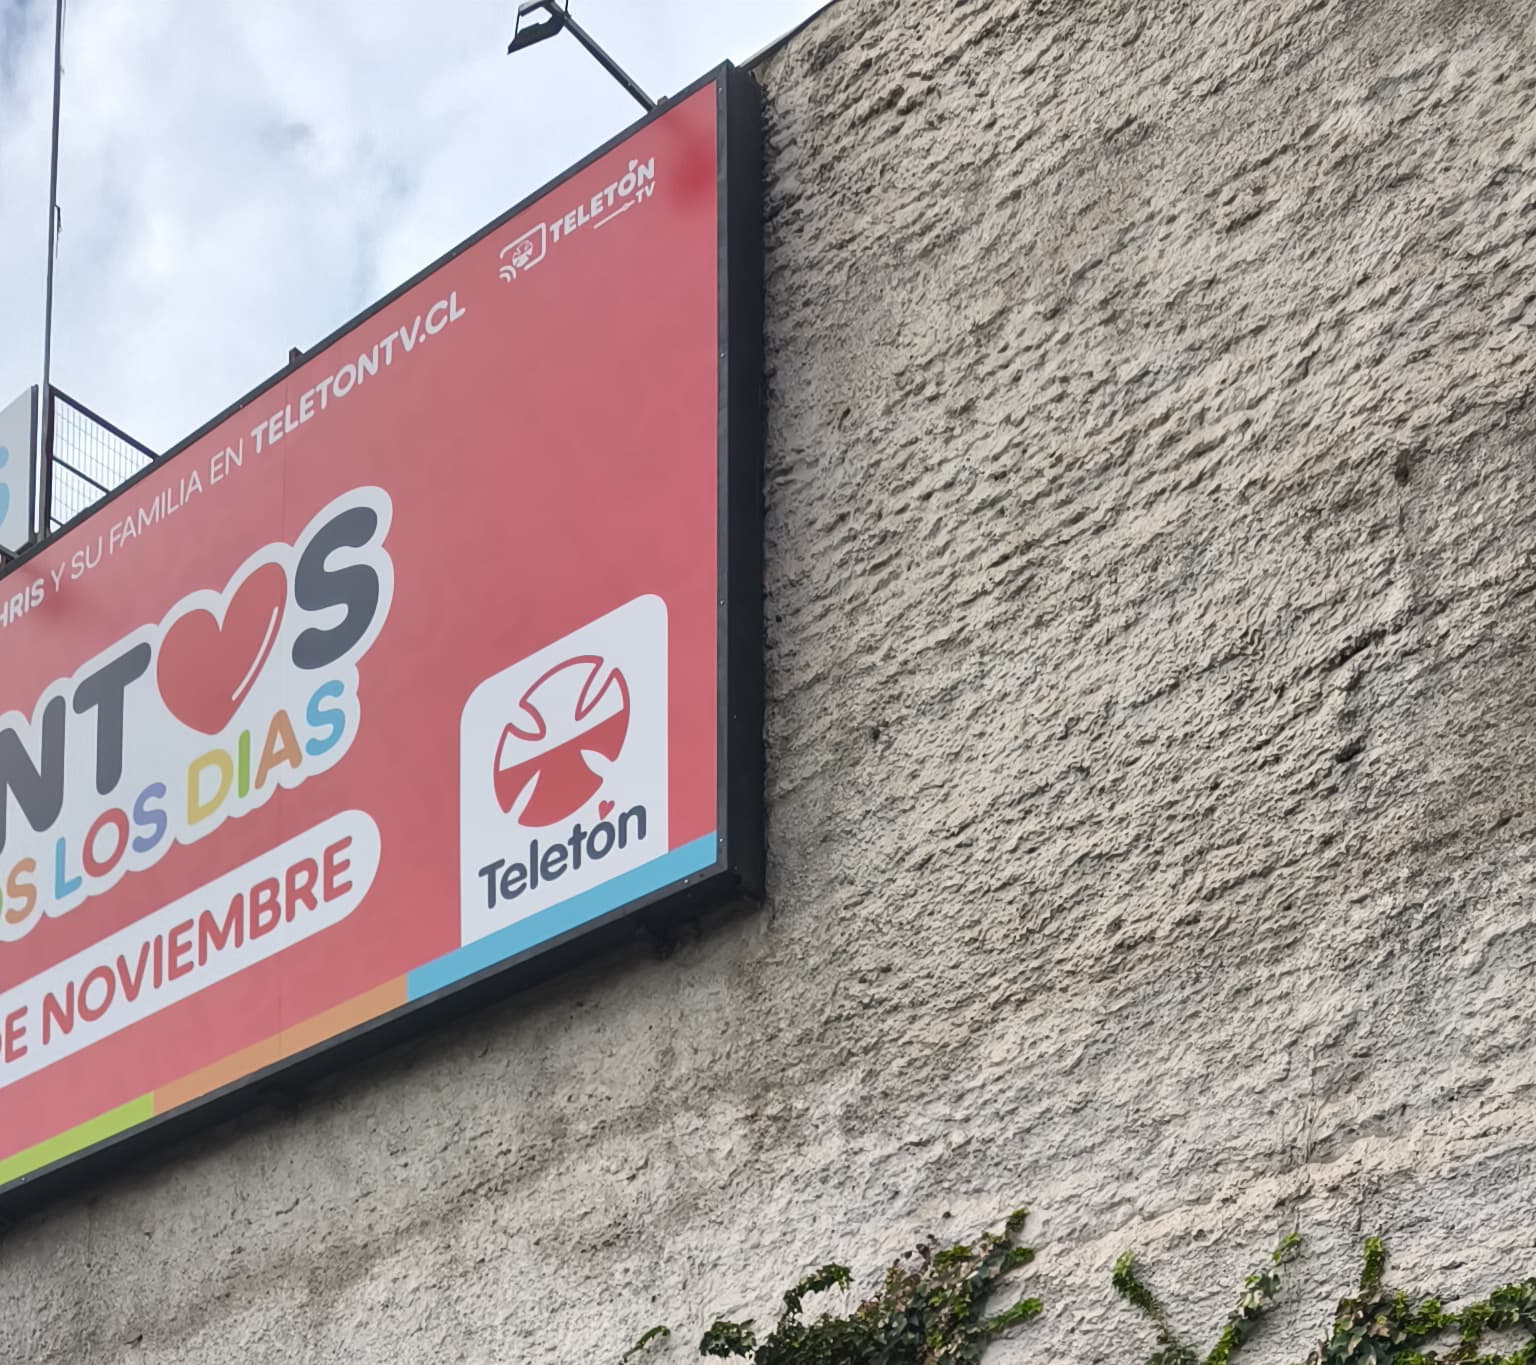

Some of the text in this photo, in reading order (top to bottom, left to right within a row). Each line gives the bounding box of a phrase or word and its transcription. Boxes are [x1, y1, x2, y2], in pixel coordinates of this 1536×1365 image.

[550, 157, 655, 243] TELETÓN
[635, 181, 655, 203] TV
[50, 562, 66, 593] Y
[71, 536, 103, 580] SU
[109, 470, 203, 555] FAMILIA
[209, 438, 244, 485] EN
[250, 291, 466, 454] TELETONTV.CL
[54, 781, 167, 901] LOS
[187, 679, 346, 827] DIAS
[41, 835, 353, 1047] NOVIEMBRE
